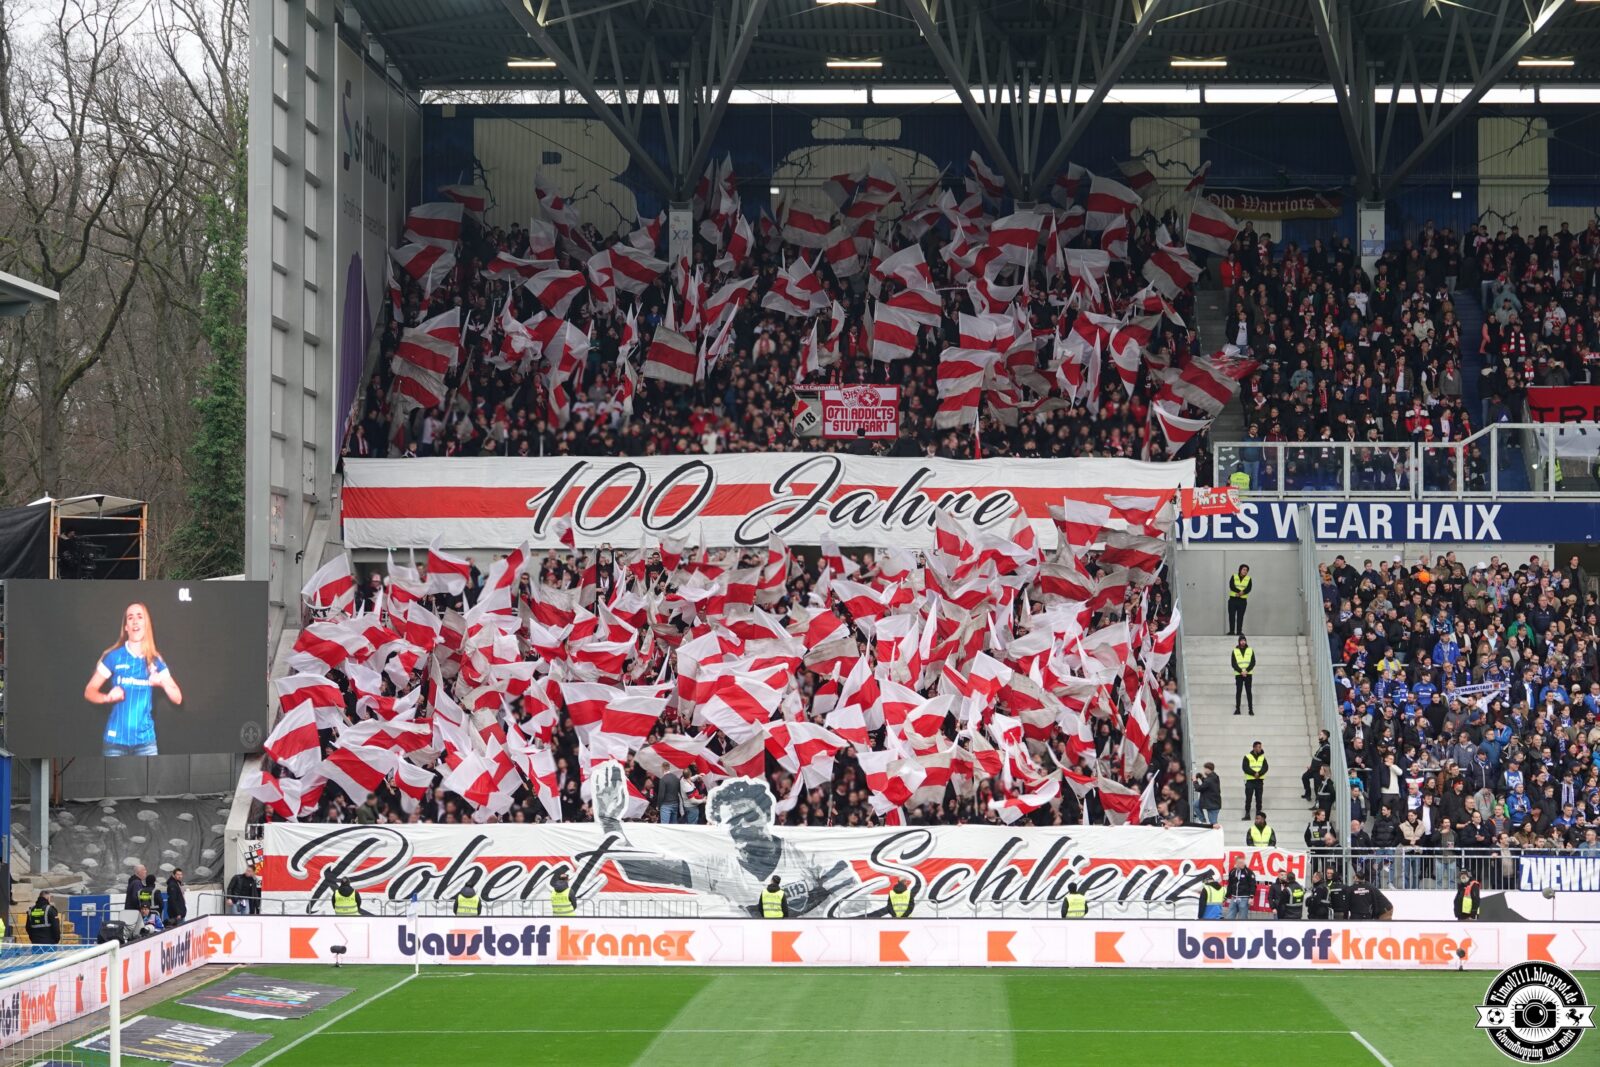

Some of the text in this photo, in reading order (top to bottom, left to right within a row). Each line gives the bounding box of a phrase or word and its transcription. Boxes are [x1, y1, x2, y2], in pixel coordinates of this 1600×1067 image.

[1241, 195, 1316, 214] Warriors
[672, 229, 689, 240] X2
[828, 407, 894, 420] 0711 ADDICTS
[833, 420, 889, 432] STUTTGART
[527, 459, 715, 536] 100
[734, 454, 1018, 545] Jahre
[1270, 503, 1393, 539] WEAR
[1406, 503, 1502, 540] HAIX
[288, 825, 1214, 918] Robert Schlienz
[1223, 850, 1305, 879] BACH
[397, 925, 692, 956] baustoff kramer
[1178, 928, 1472, 960] baustoff kramer
